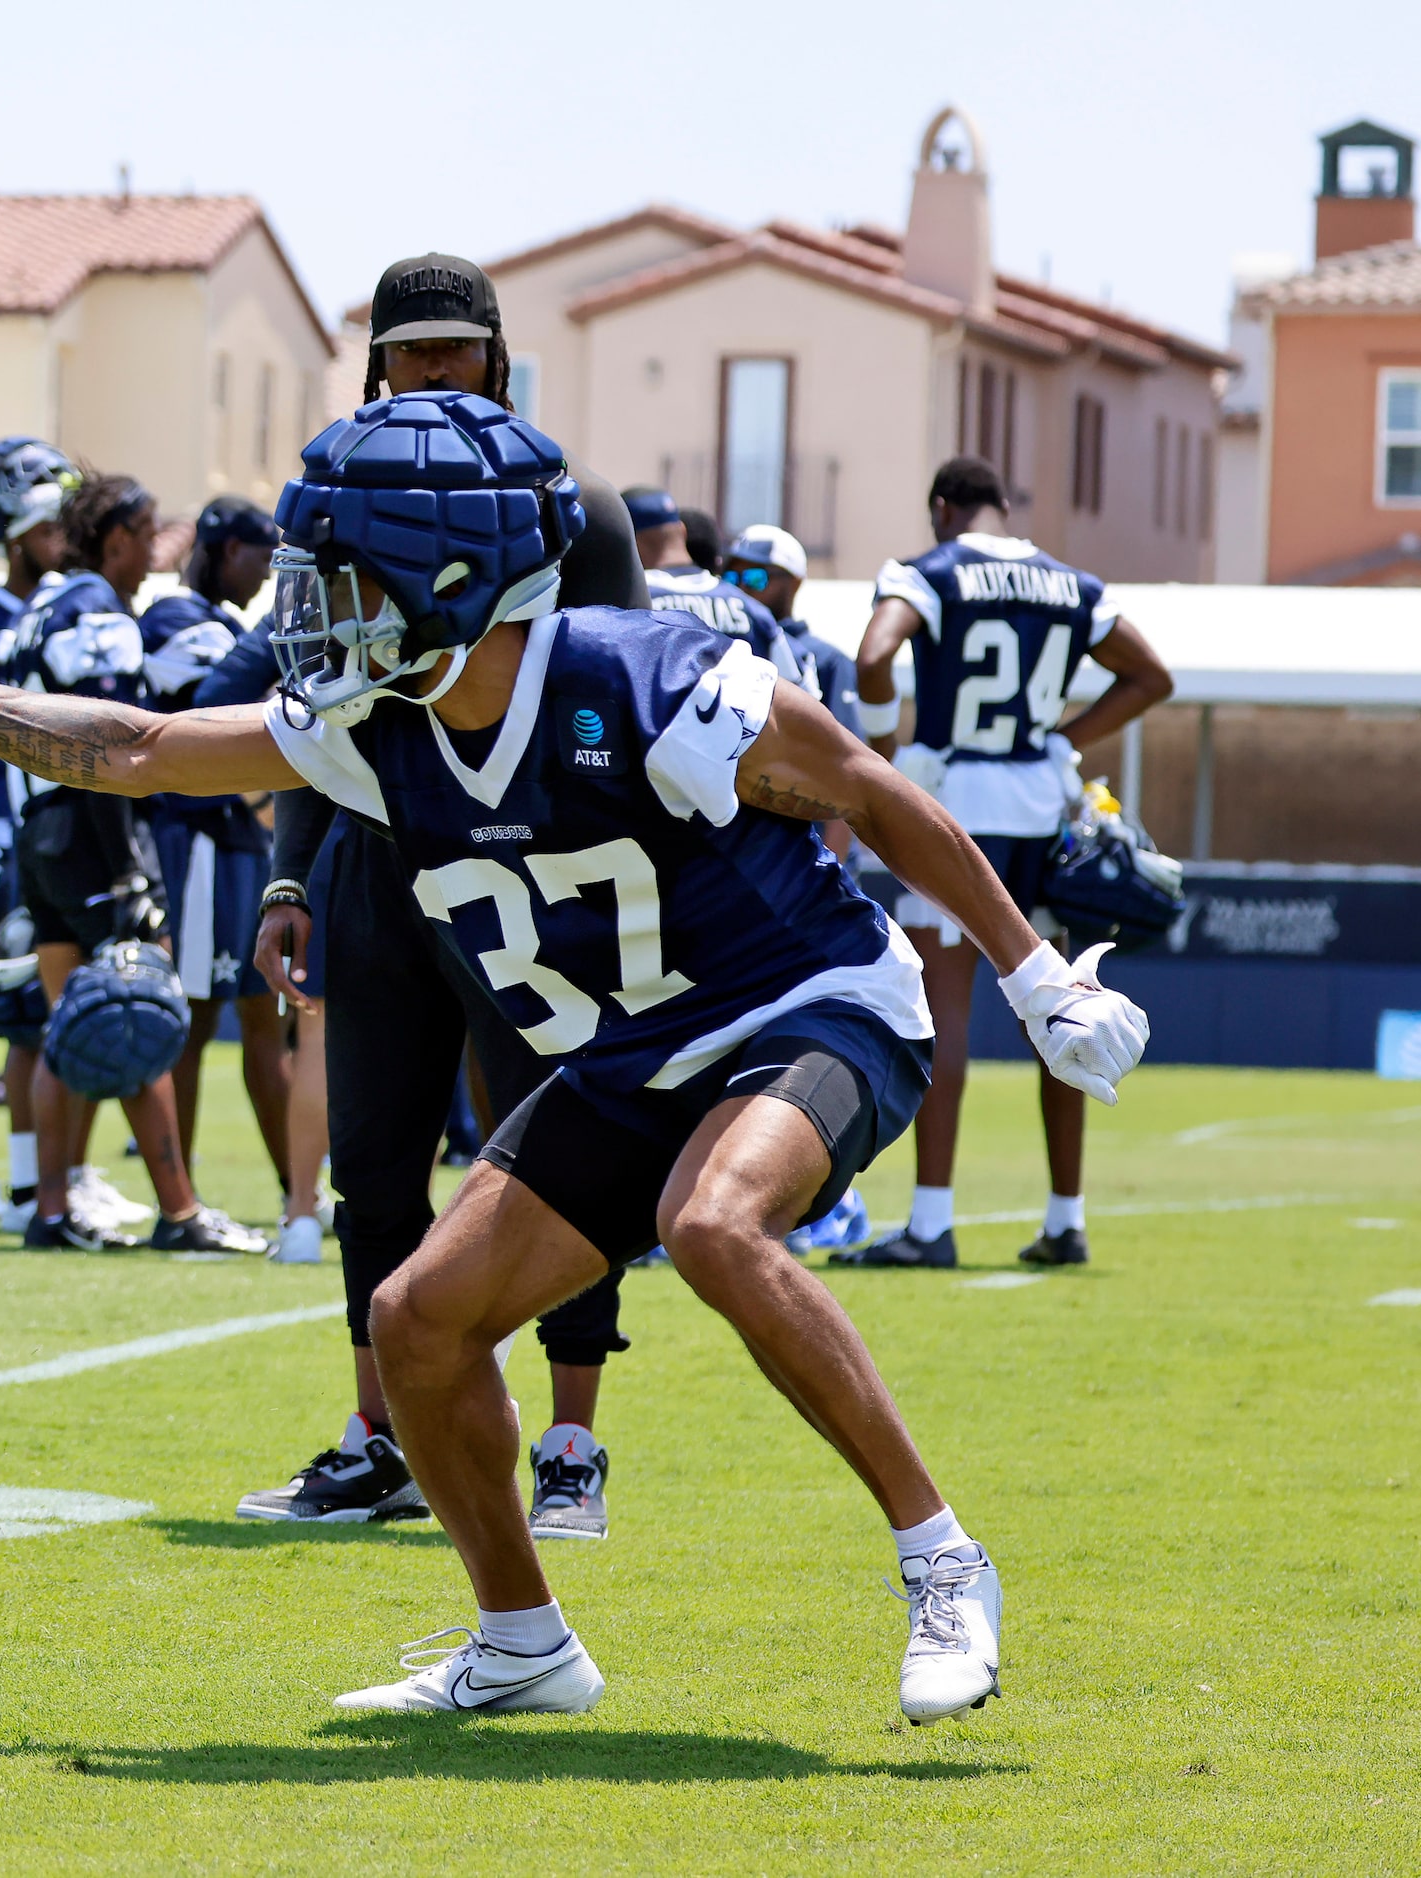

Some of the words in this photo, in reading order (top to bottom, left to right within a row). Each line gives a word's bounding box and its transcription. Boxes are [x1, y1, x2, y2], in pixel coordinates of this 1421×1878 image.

[389, 265, 474, 306] DALLAS
[954, 562, 1081, 609] MUKUAMU
[951, 619, 1073, 755] 24
[574, 749, 612, 767] AT&T
[471, 825, 533, 843] COWBOYS
[412, 837, 697, 1056] 37
